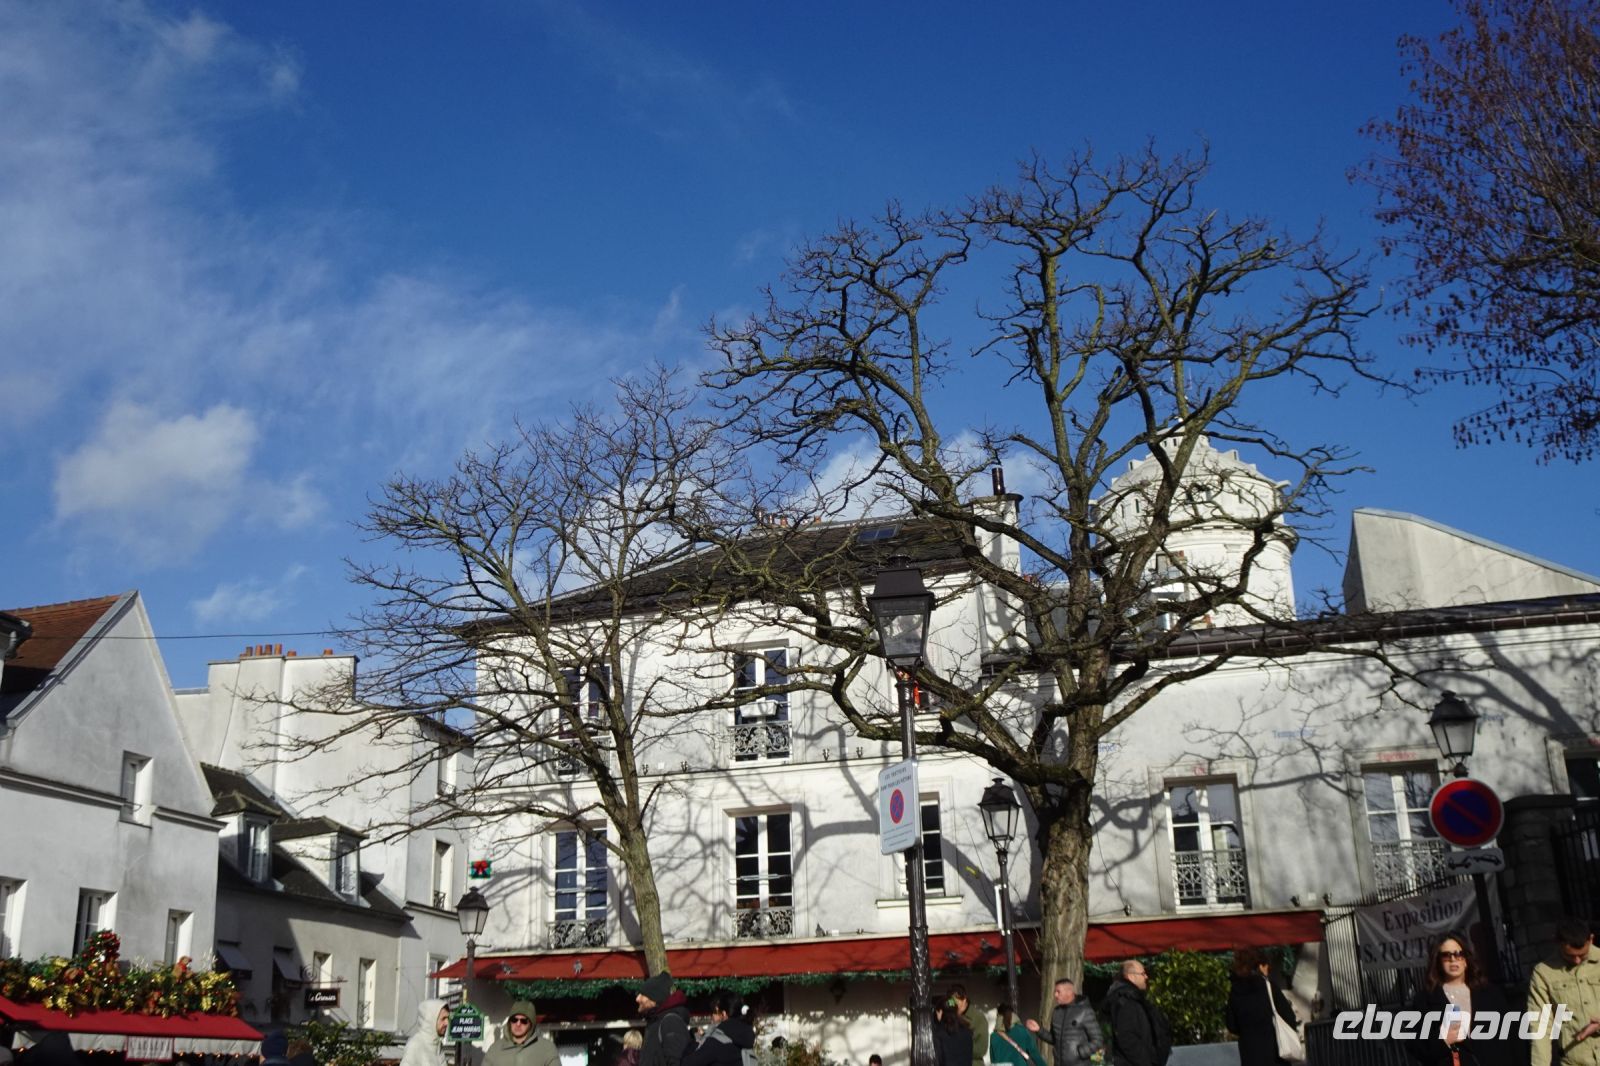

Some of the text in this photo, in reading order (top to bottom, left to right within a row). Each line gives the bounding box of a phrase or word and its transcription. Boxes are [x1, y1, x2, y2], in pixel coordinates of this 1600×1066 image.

[1382, 899, 1463, 933] Exposition
[459, 1017, 474, 1025] PLACE
[451, 1025, 481, 1033] JEAN MARAIS
